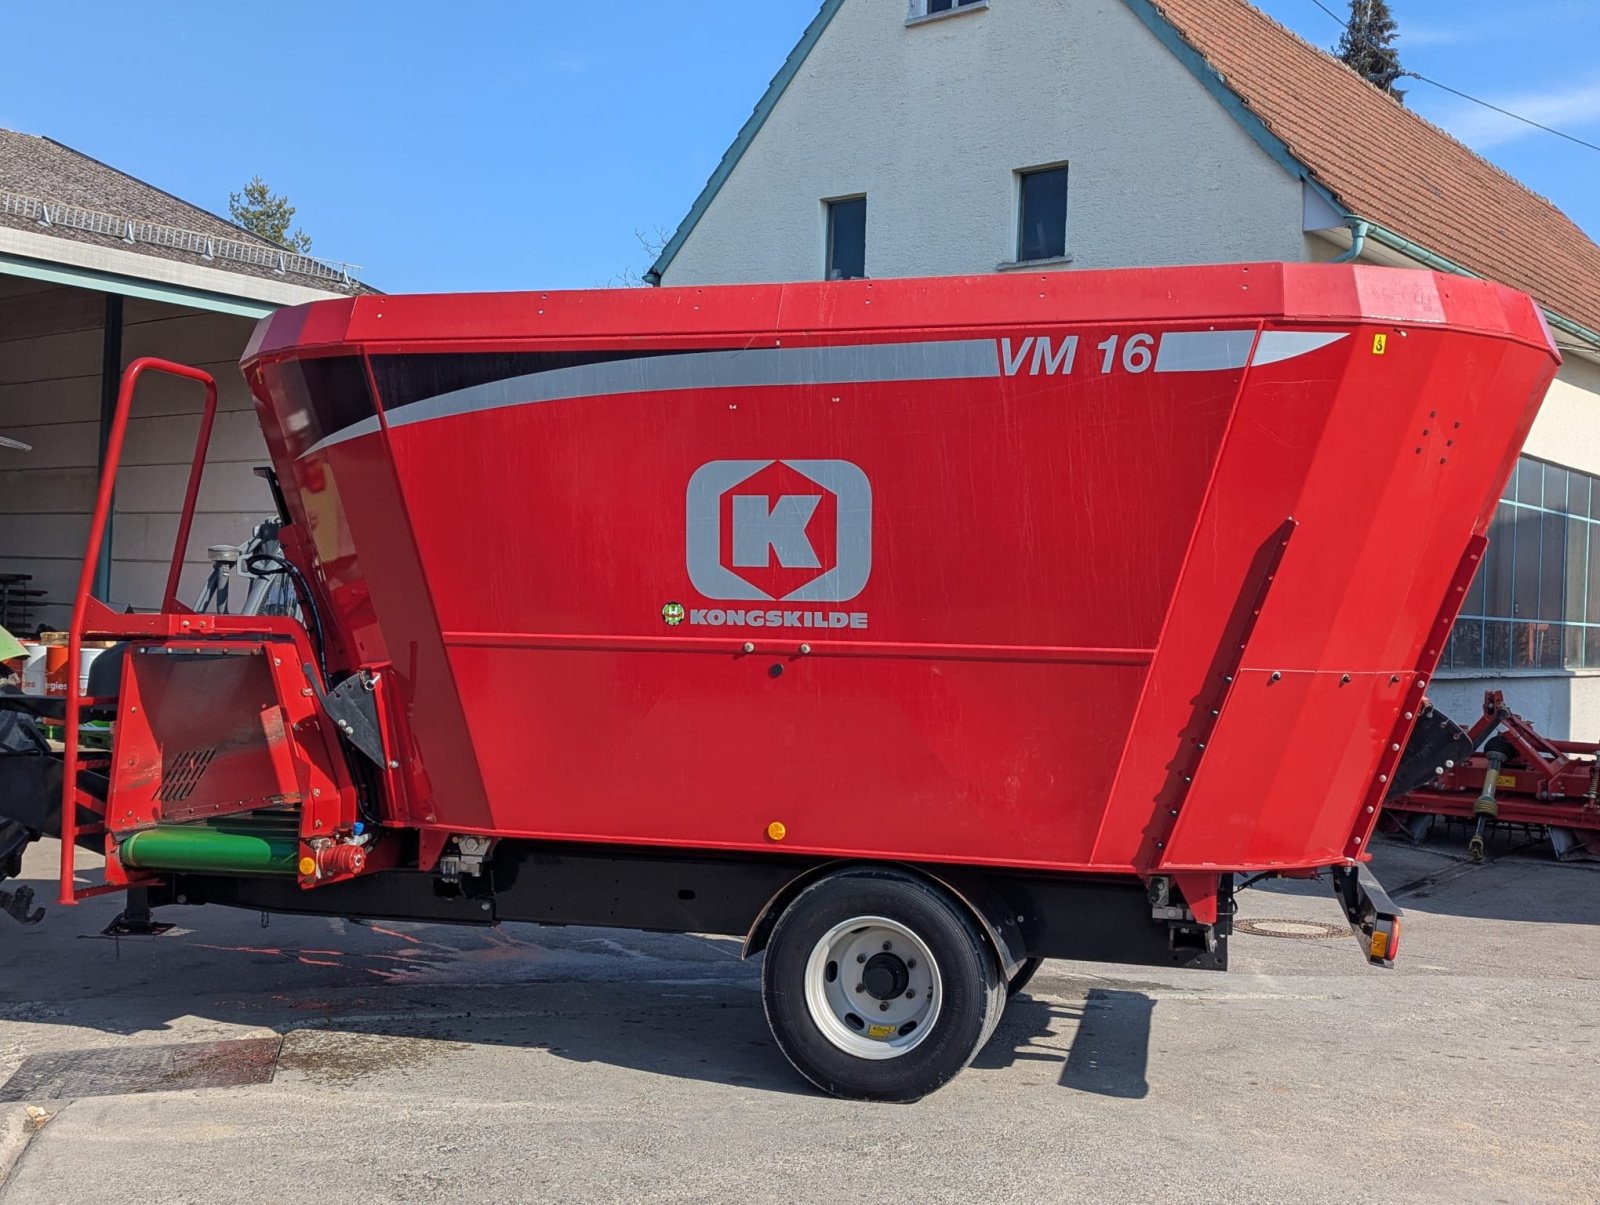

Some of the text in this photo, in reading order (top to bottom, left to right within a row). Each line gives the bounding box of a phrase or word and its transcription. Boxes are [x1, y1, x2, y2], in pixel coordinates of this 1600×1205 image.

[1001, 332, 1155, 377] VM 16
[732, 494, 822, 569] K
[689, 609, 868, 629] KONGSKILDE
